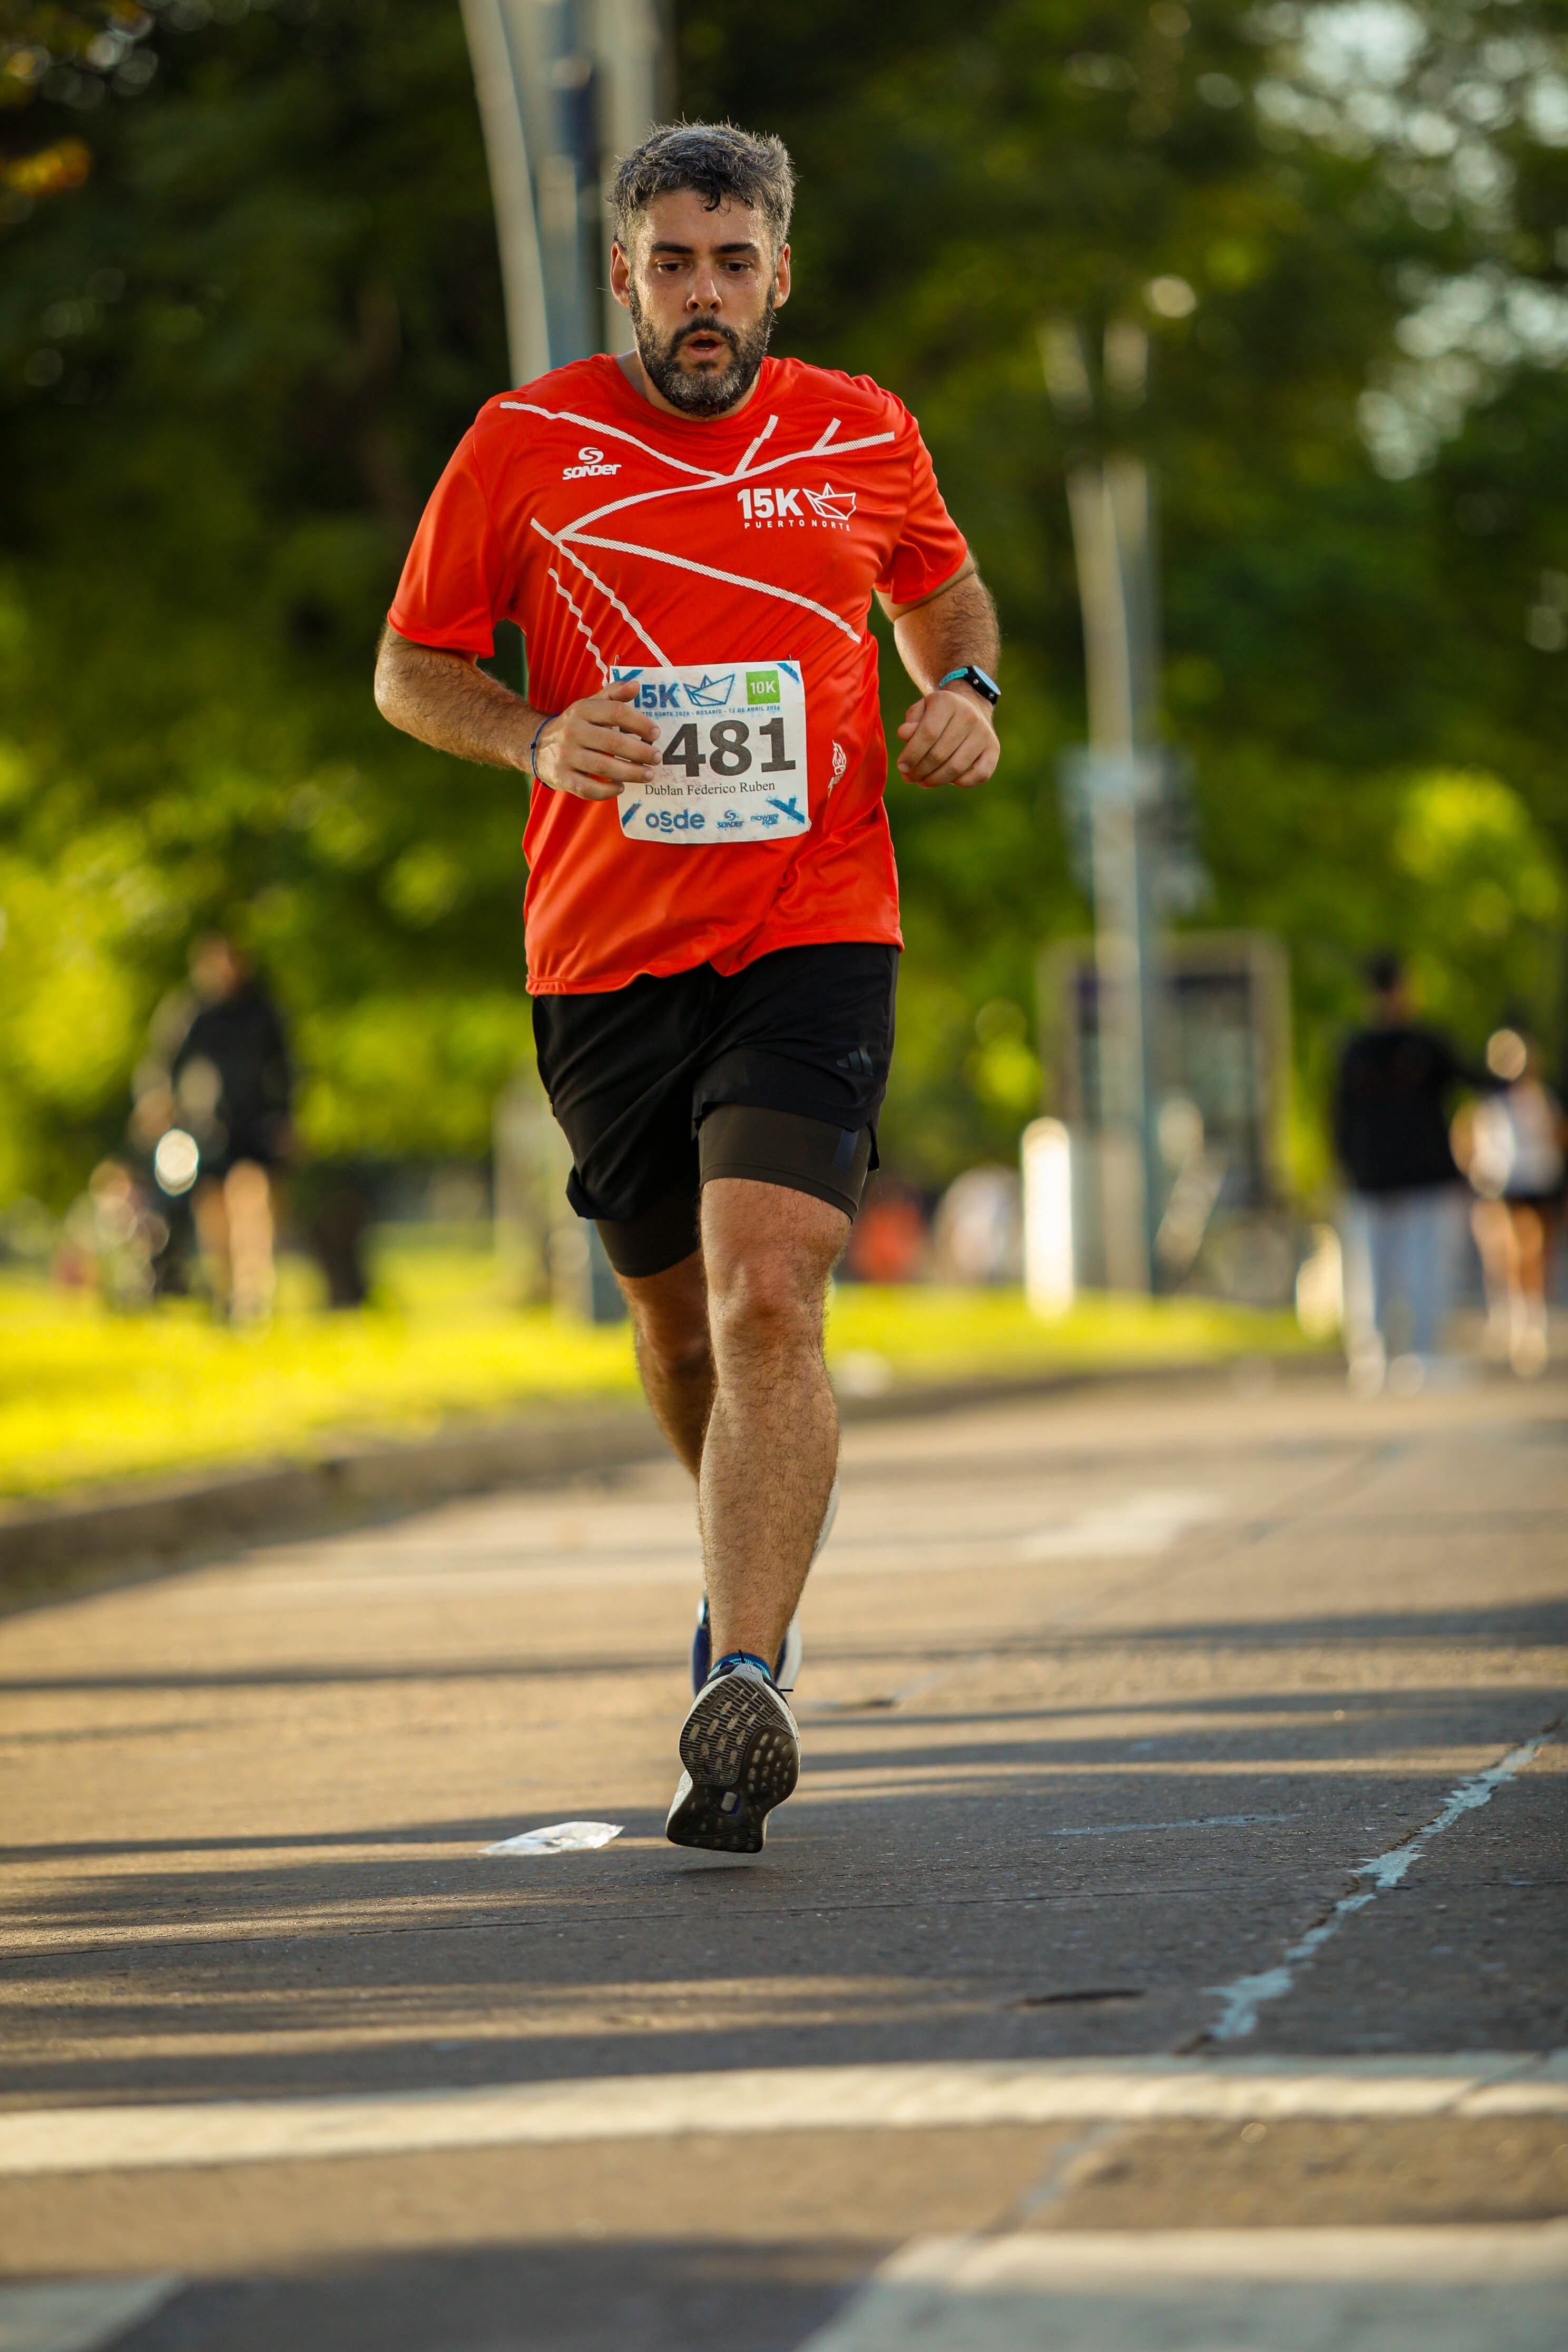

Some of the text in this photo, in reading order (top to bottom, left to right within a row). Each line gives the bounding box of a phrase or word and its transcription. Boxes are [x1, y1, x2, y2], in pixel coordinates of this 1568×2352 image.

[737, 488, 804, 519] 15K
[744, 520, 850, 531] PUERTO NORTE
[750, 681, 777, 694] 10K
[619, 717, 796, 777] 481
[644, 781, 776, 796] Dublan Federico Ruben
[645, 809, 705, 830] osde
